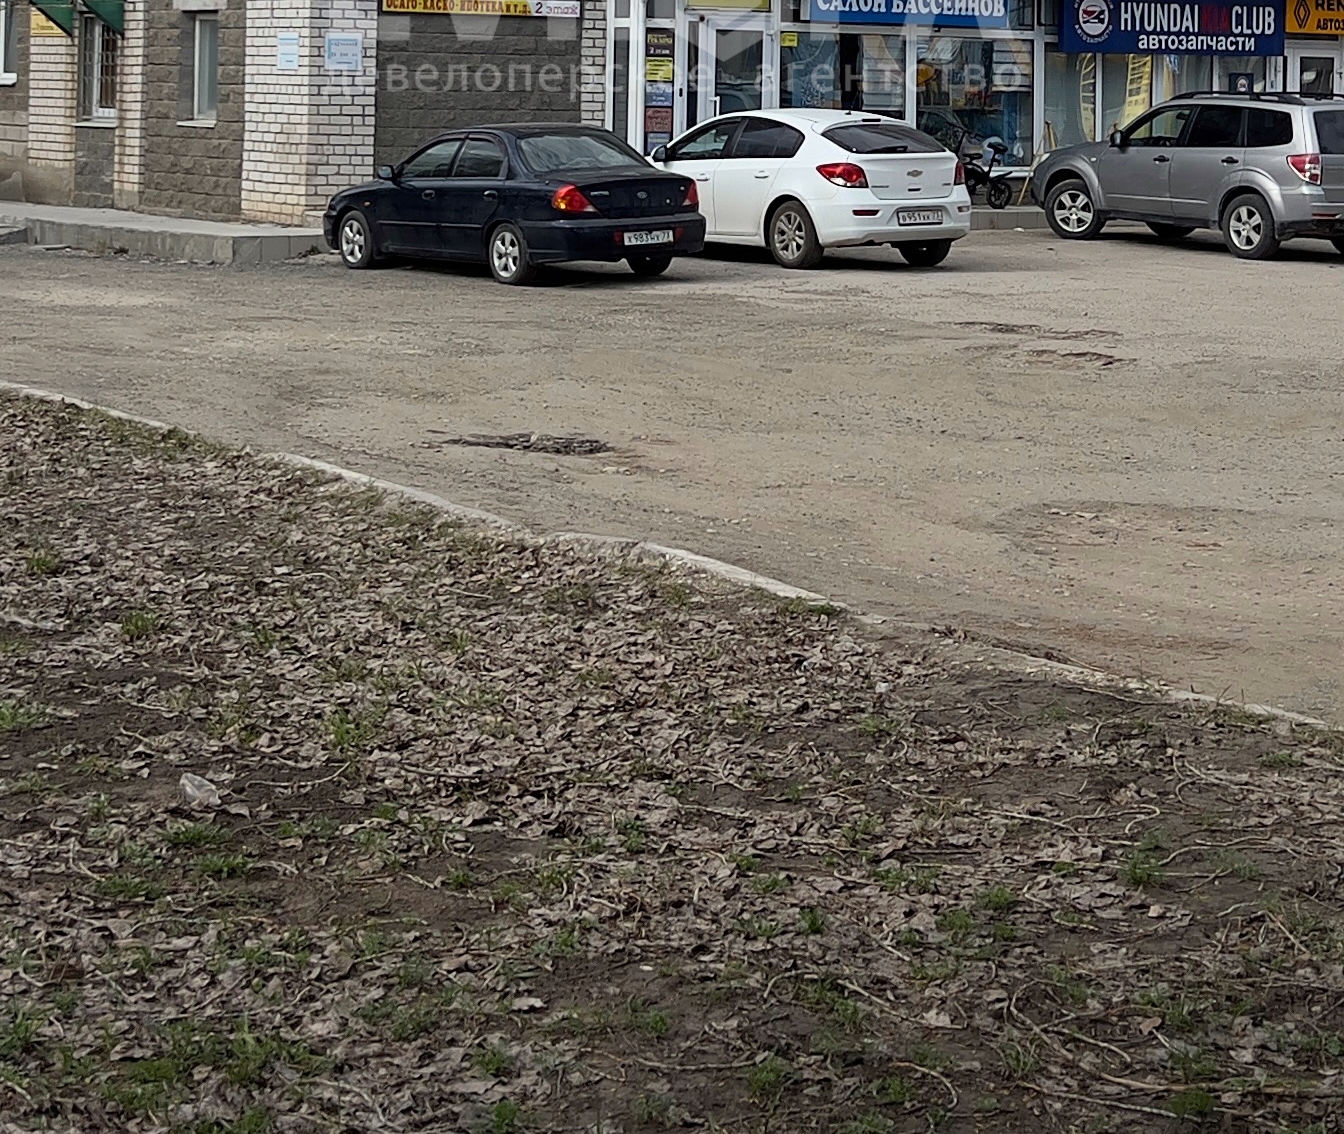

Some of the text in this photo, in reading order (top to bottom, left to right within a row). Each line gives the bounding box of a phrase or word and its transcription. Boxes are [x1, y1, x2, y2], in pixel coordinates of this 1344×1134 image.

[535, 2, 578, 16] 2 этаж
[1120, 1, 1198, 33] HYUNDAI
[1231, 5, 1275, 35] CLUB
[1138, 34, 1255, 52] автозапчасти
